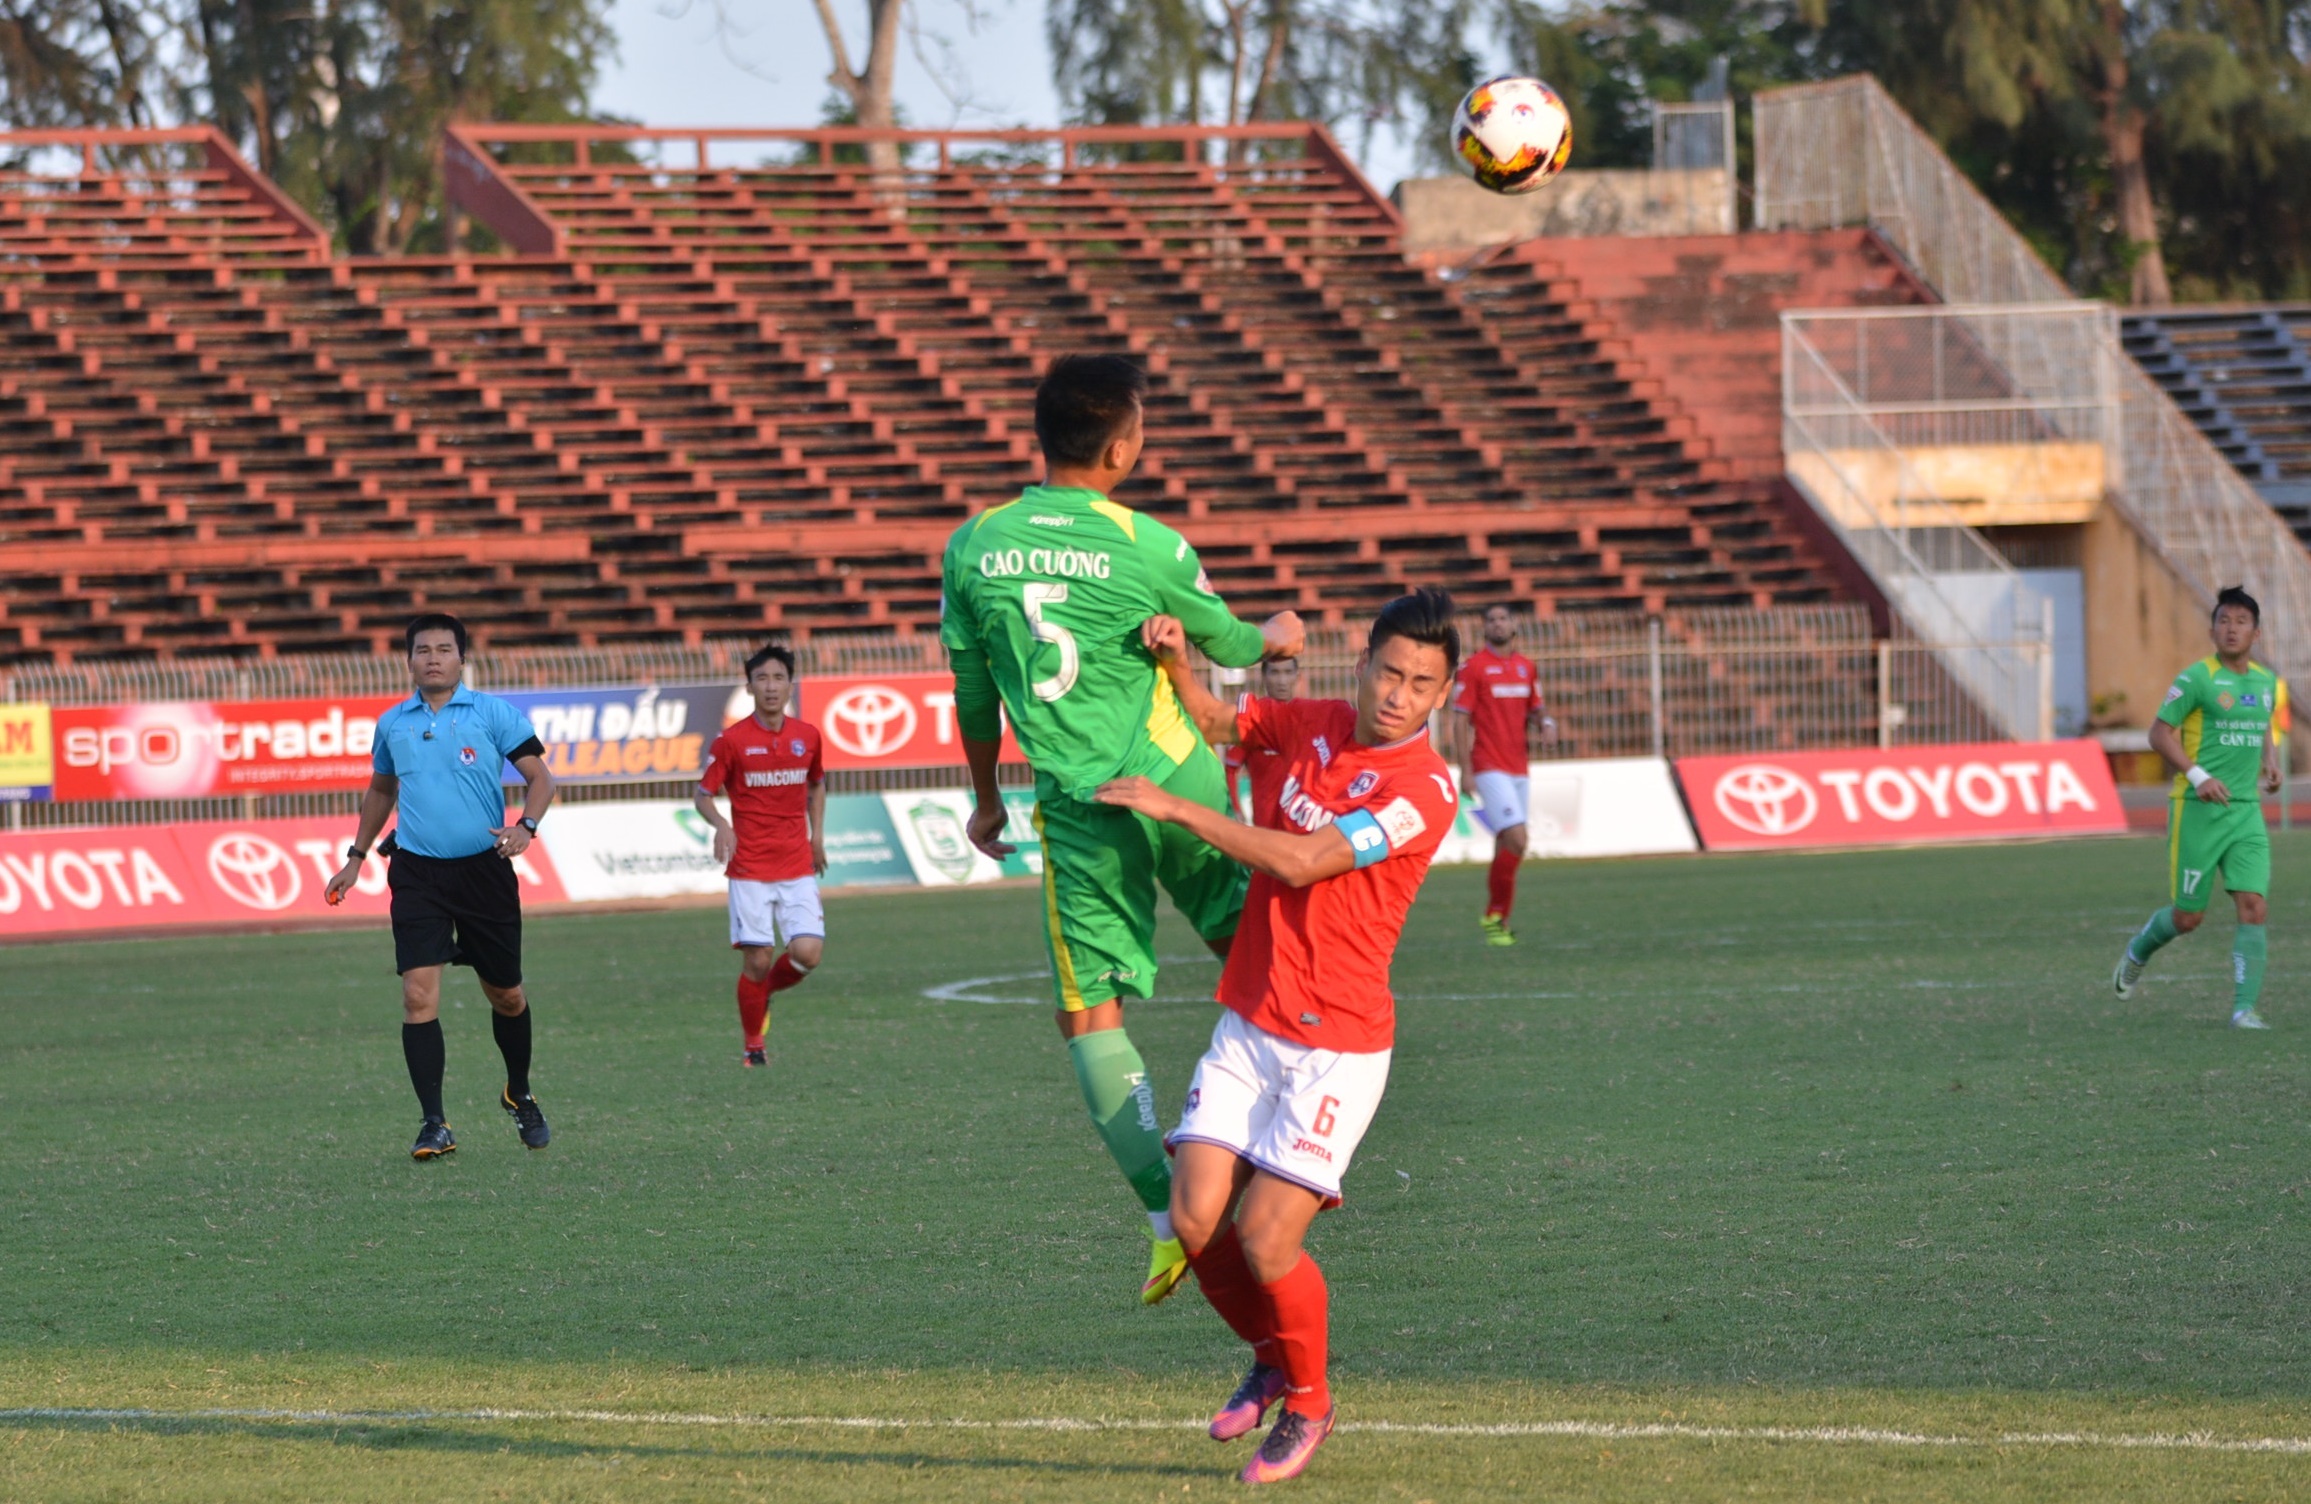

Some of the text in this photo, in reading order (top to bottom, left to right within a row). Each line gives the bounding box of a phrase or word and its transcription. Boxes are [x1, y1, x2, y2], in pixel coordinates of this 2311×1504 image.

[980, 549, 1024, 578] CAO
[1022, 582, 1079, 702] 5
[530, 704, 596, 743] THI
[1818, 760, 2097, 823] TOYOTA
[2183, 868, 2202, 895] 17
[1312, 1094, 1341, 1138] 6
